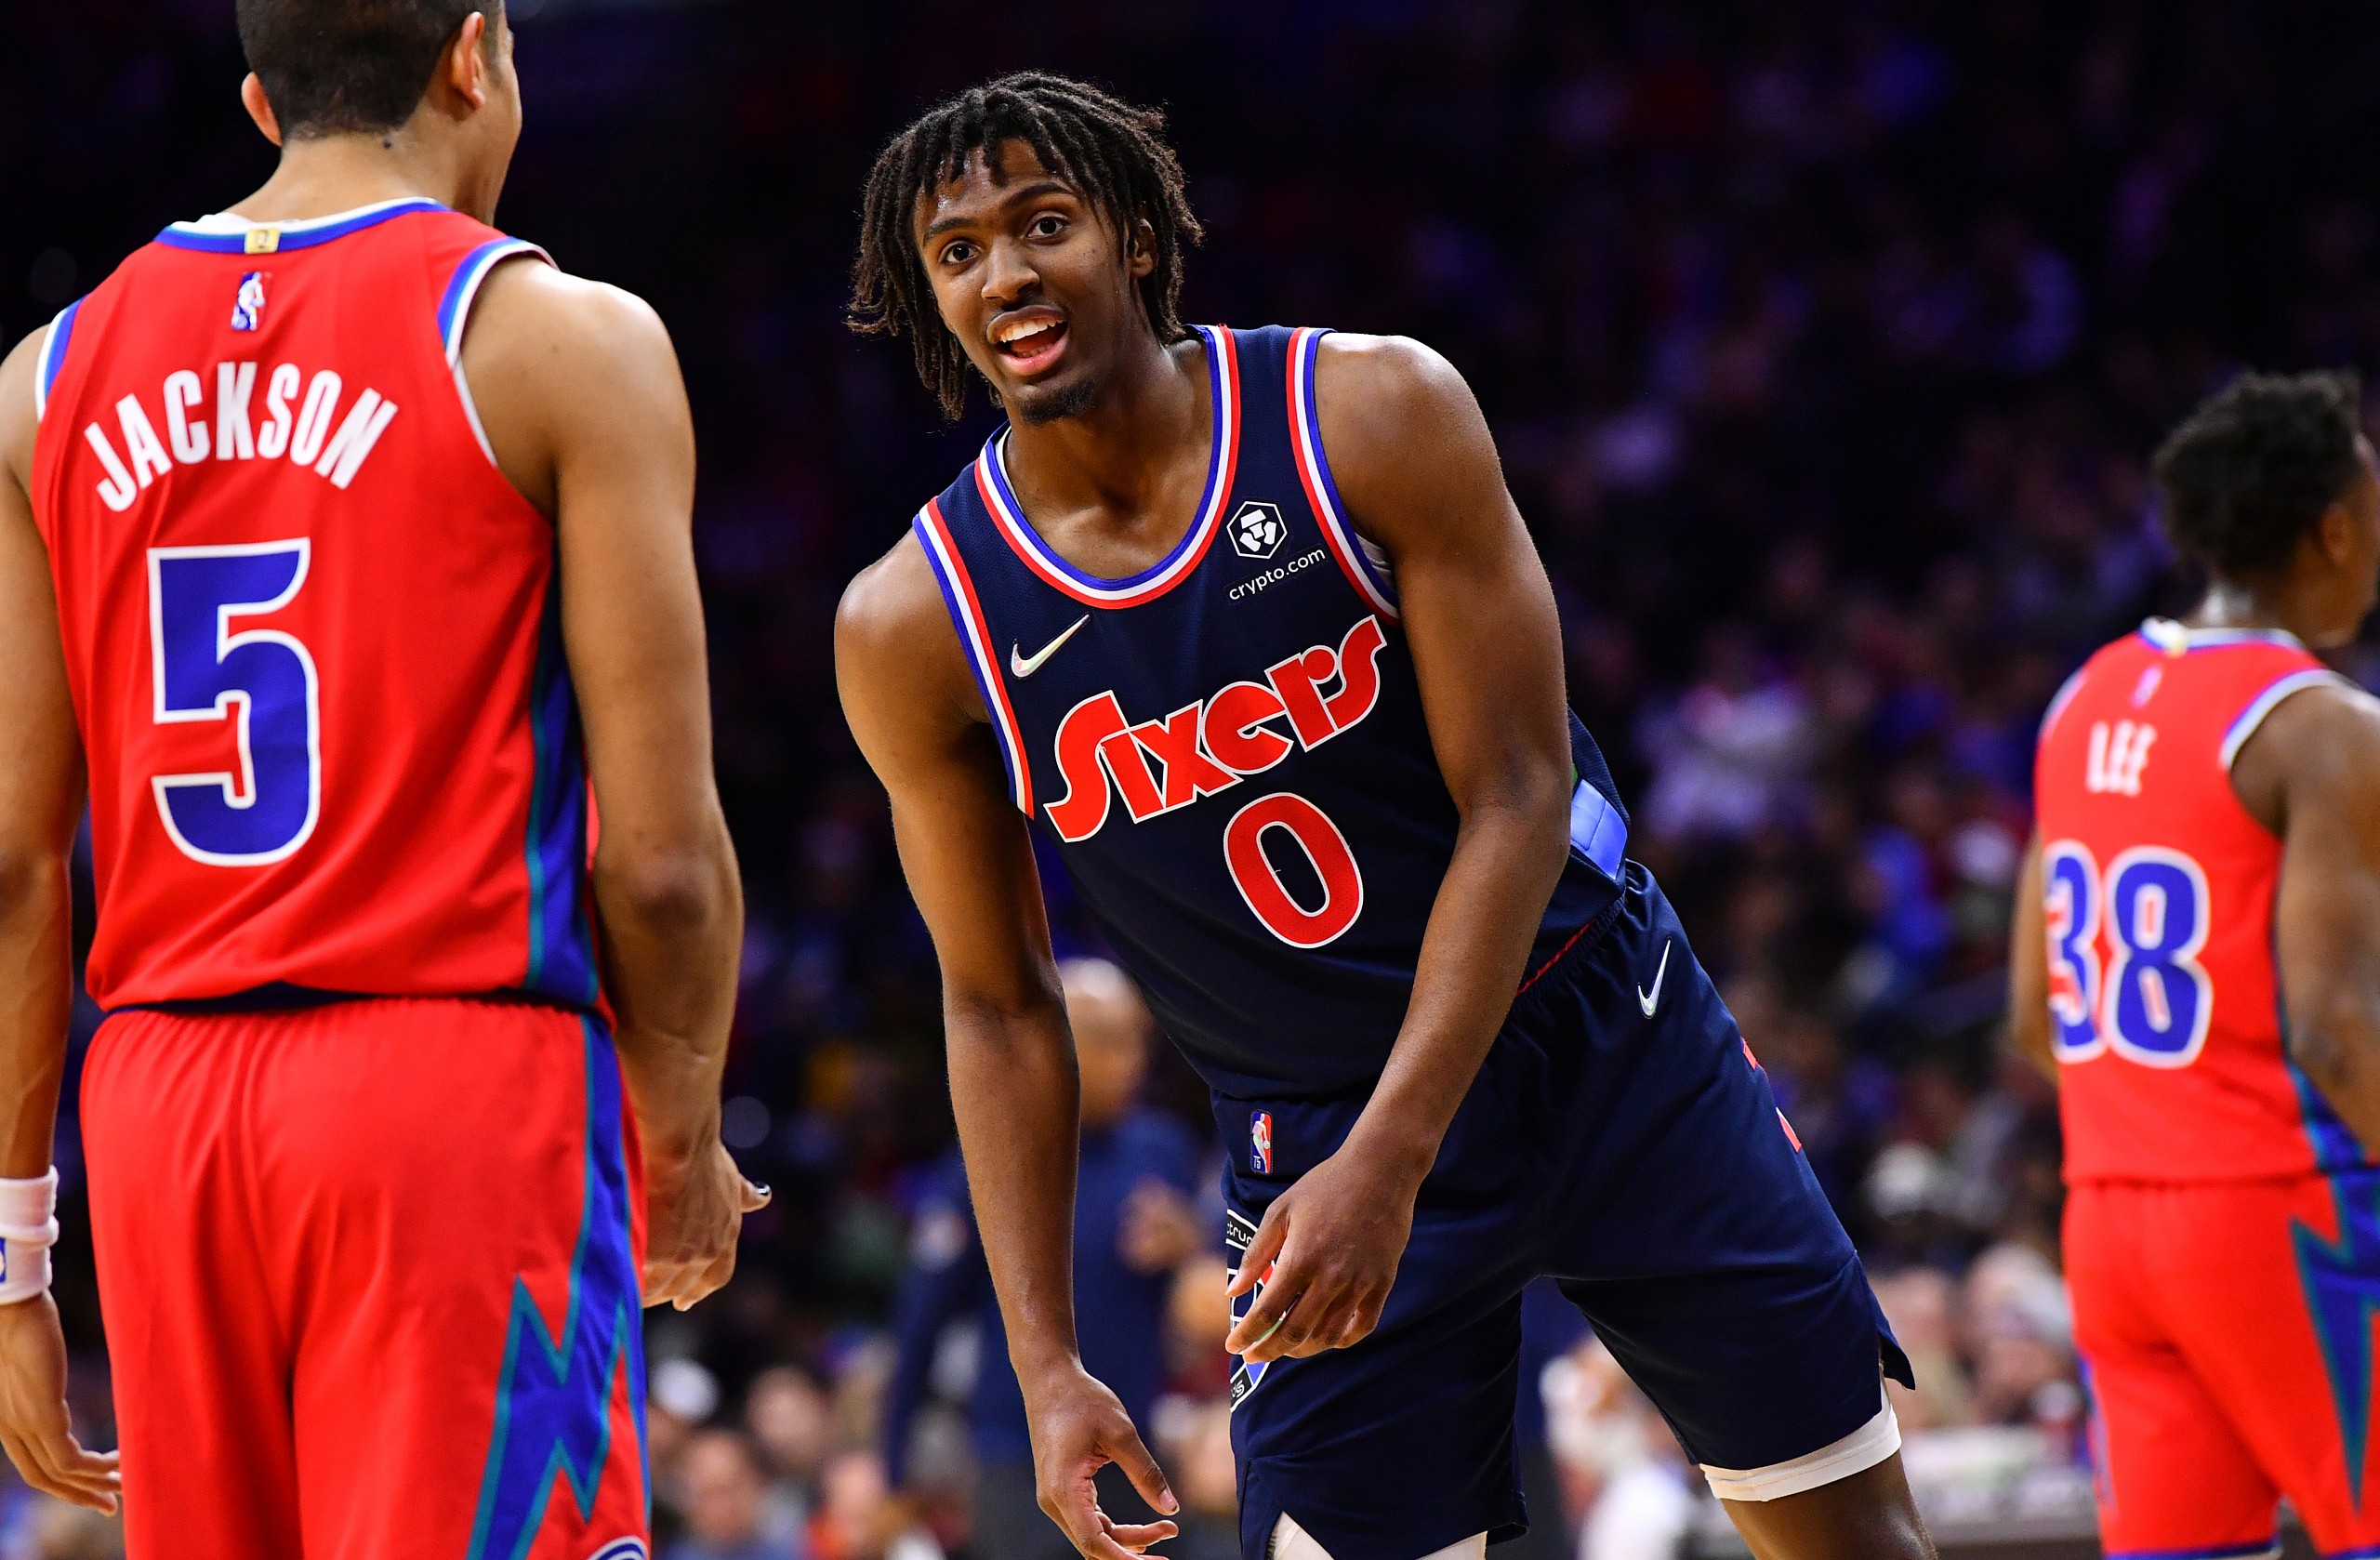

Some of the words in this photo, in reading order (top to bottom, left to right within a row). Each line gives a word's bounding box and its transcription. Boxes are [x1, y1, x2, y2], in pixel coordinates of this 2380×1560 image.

[85, 362, 398, 511] JACKSON
[1229, 549, 1326, 600] crypto.com
[147, 536, 321, 866] 5
[1043, 614, 1387, 842] Sixers
[2085, 719, 2156, 797] LEE
[1223, 792, 1364, 949] 0
[2043, 839, 2214, 1069] 38
